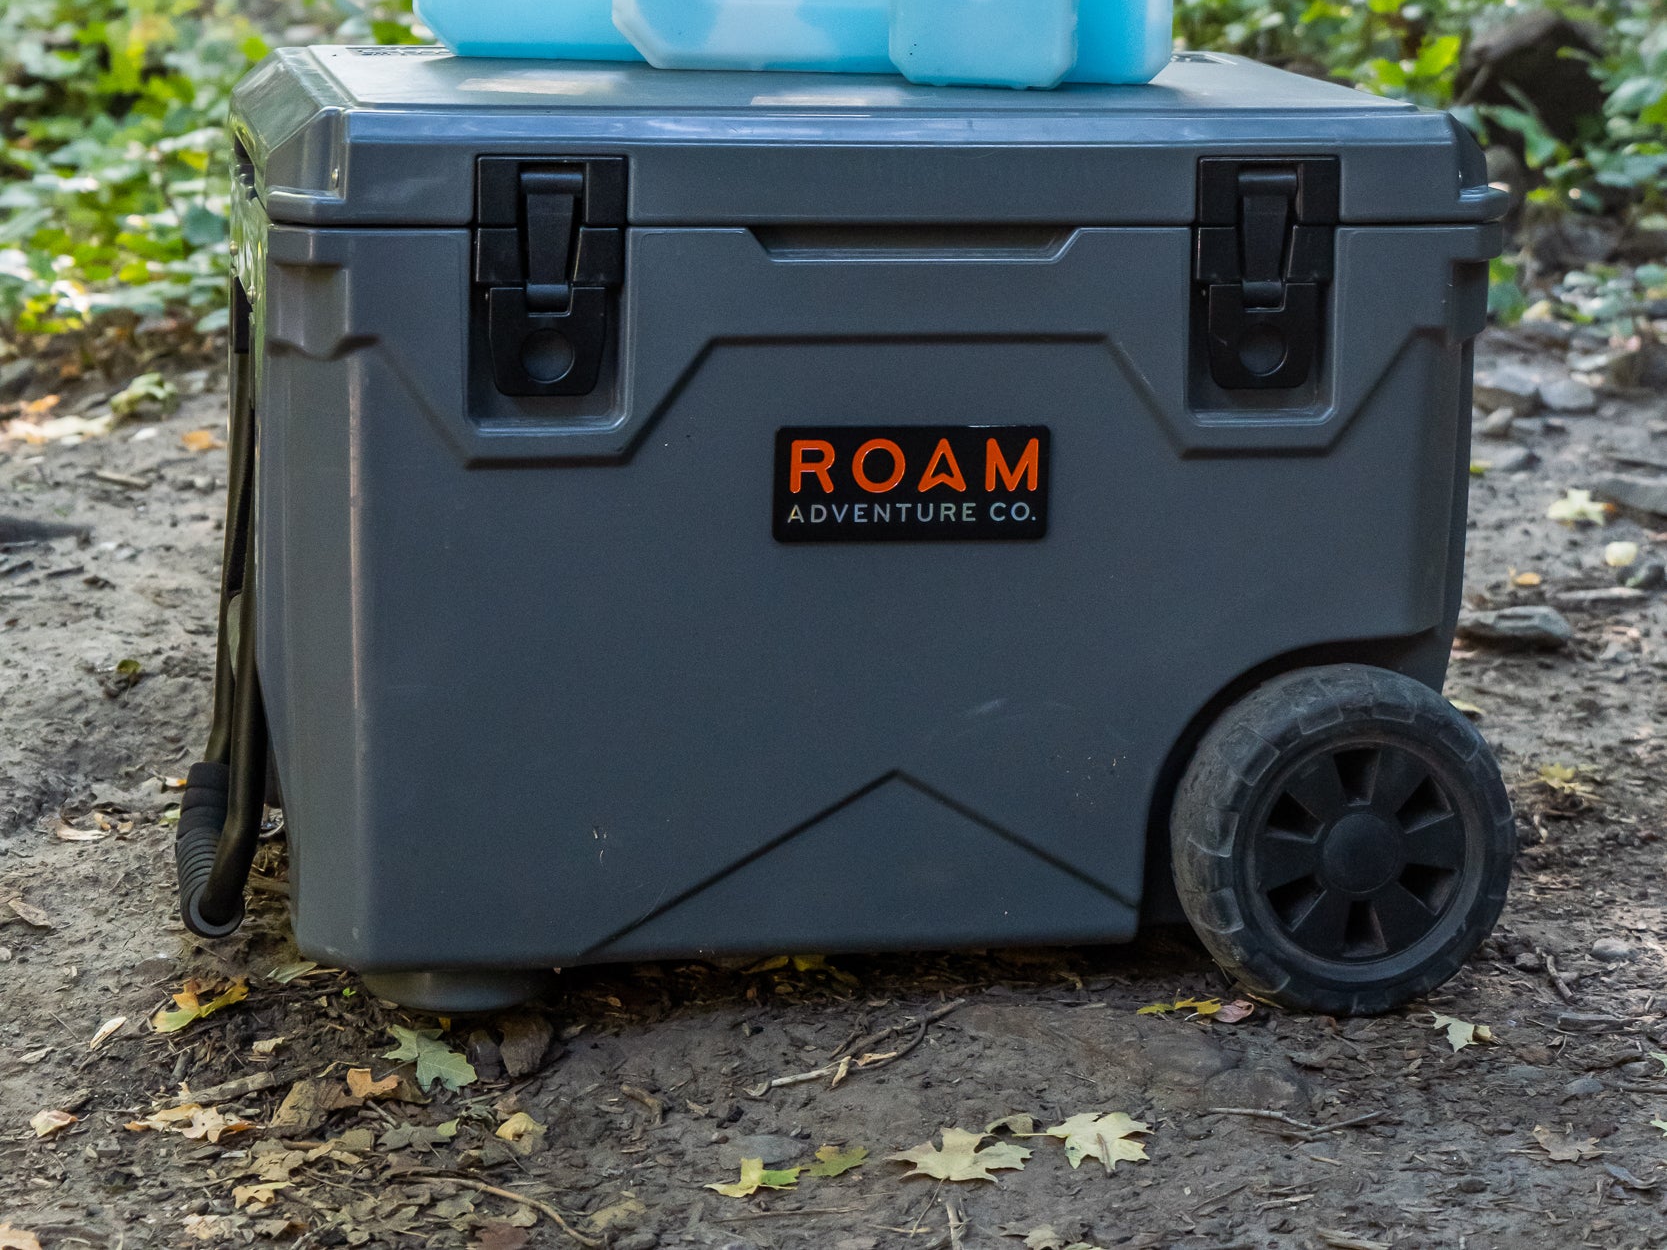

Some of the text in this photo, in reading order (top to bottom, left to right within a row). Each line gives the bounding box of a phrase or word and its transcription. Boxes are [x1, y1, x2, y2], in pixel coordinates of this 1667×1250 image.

[789, 438, 1039, 494] ROAM
[787, 501, 1037, 524] ADVENTURE CO.
